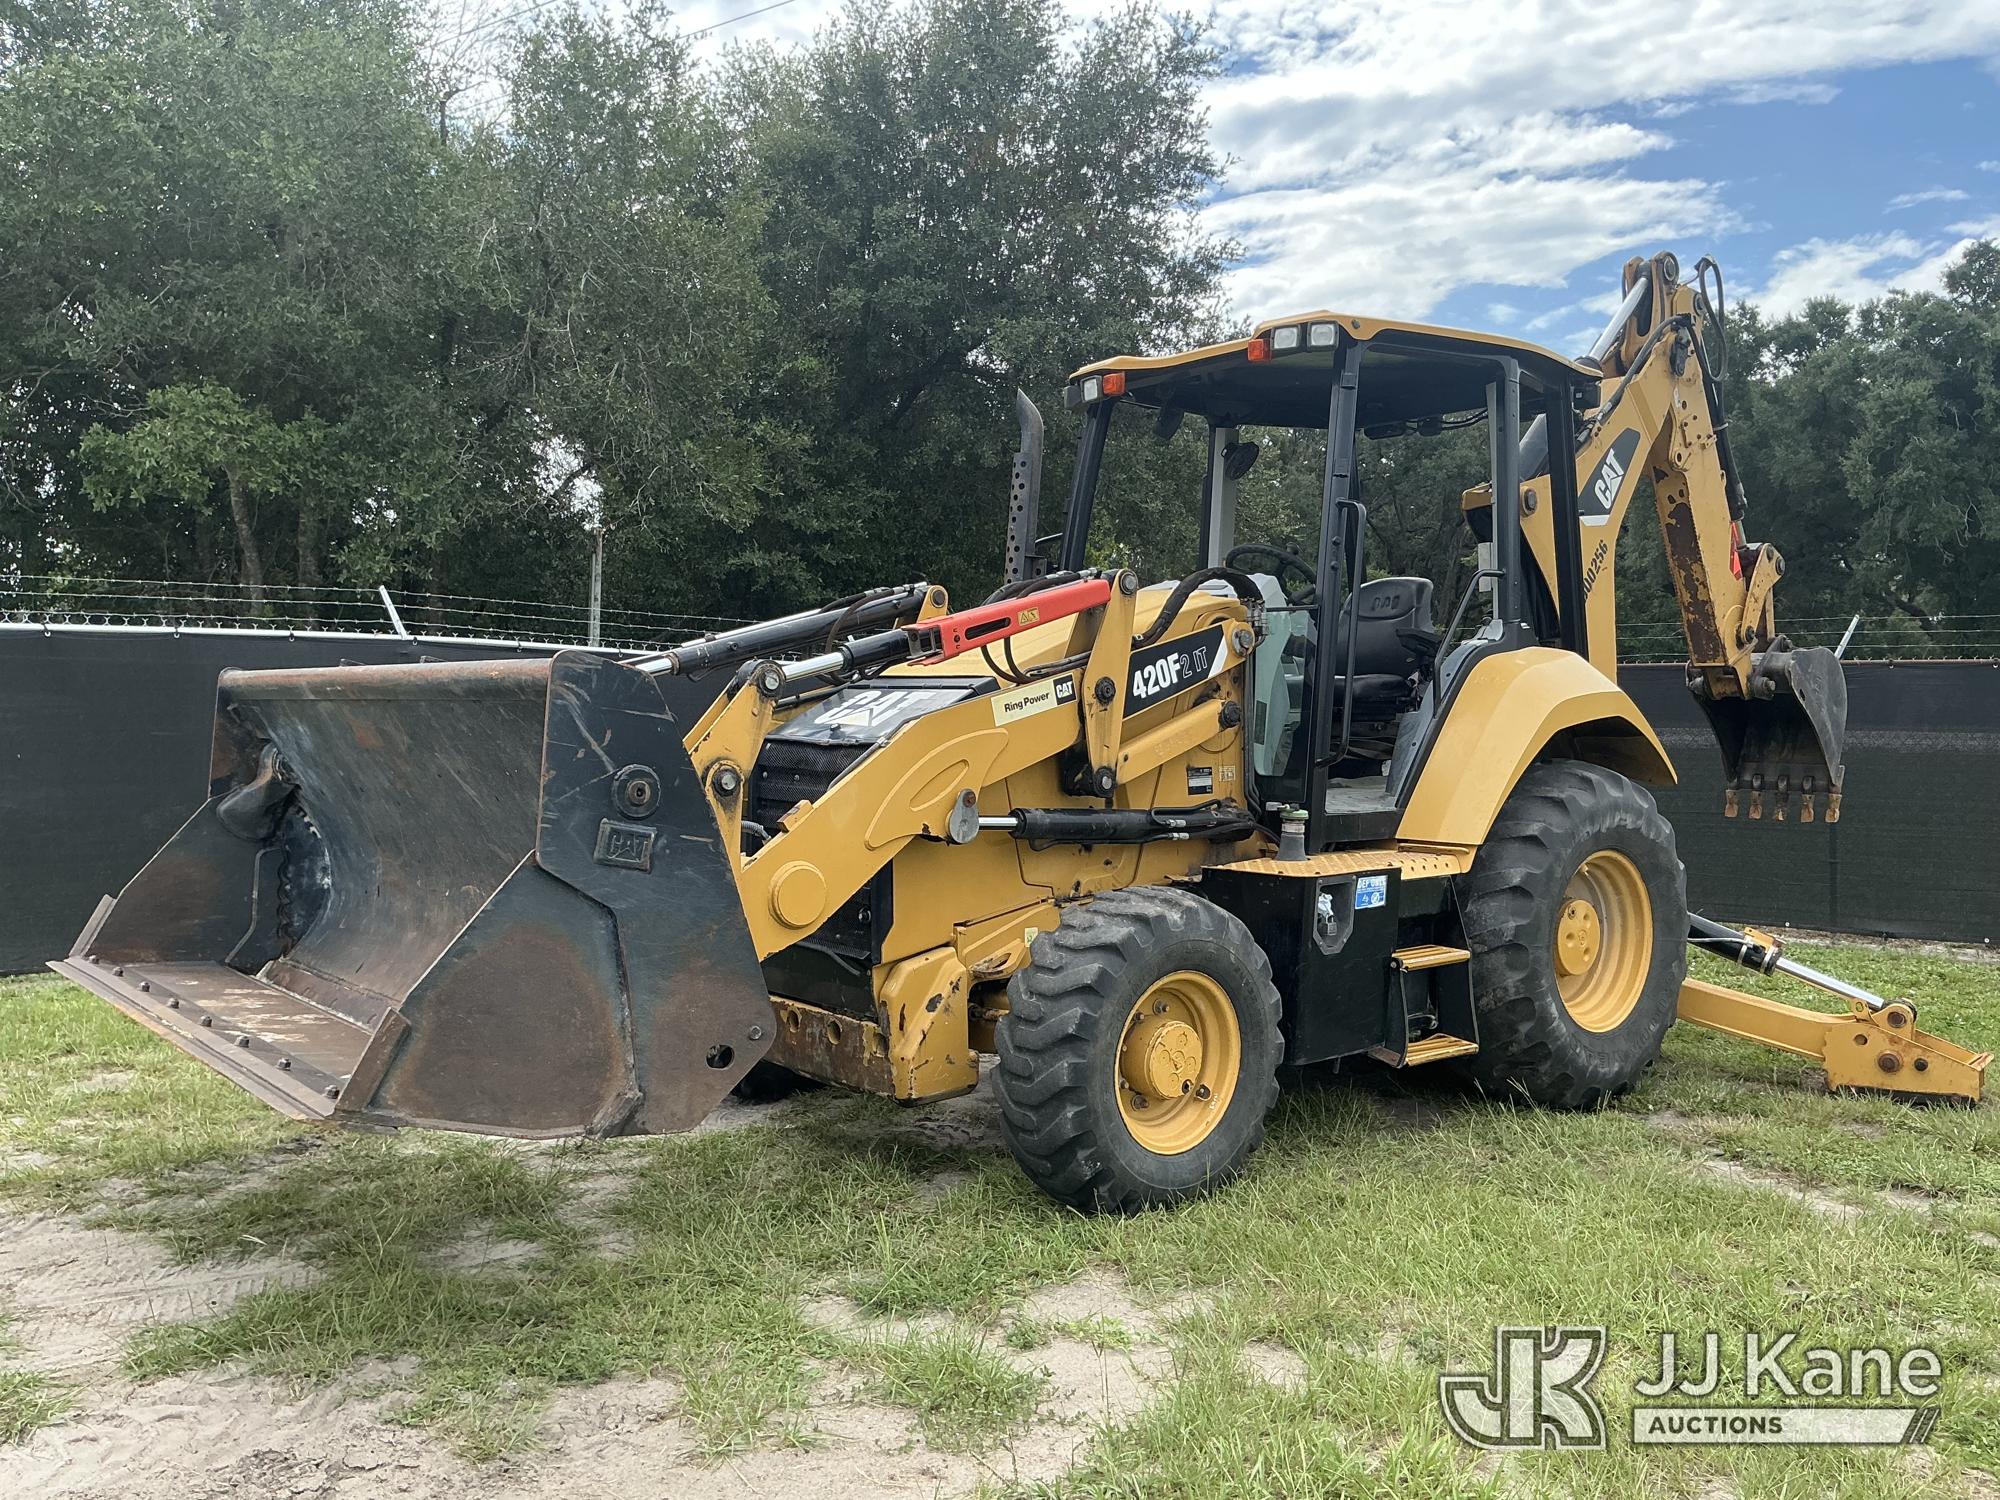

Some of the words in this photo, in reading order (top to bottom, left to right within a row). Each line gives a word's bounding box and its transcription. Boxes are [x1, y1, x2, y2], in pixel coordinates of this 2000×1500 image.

[1594, 447, 1625, 510] CAT
[1583, 539, 1608, 600] 00256
[813, 690, 938, 727] CAT
[1004, 701, 1024, 713] Ring
[1023, 692, 1050, 707] Power
[1055, 680, 1073, 699] CAT
[606, 833, 649, 864] CAT
